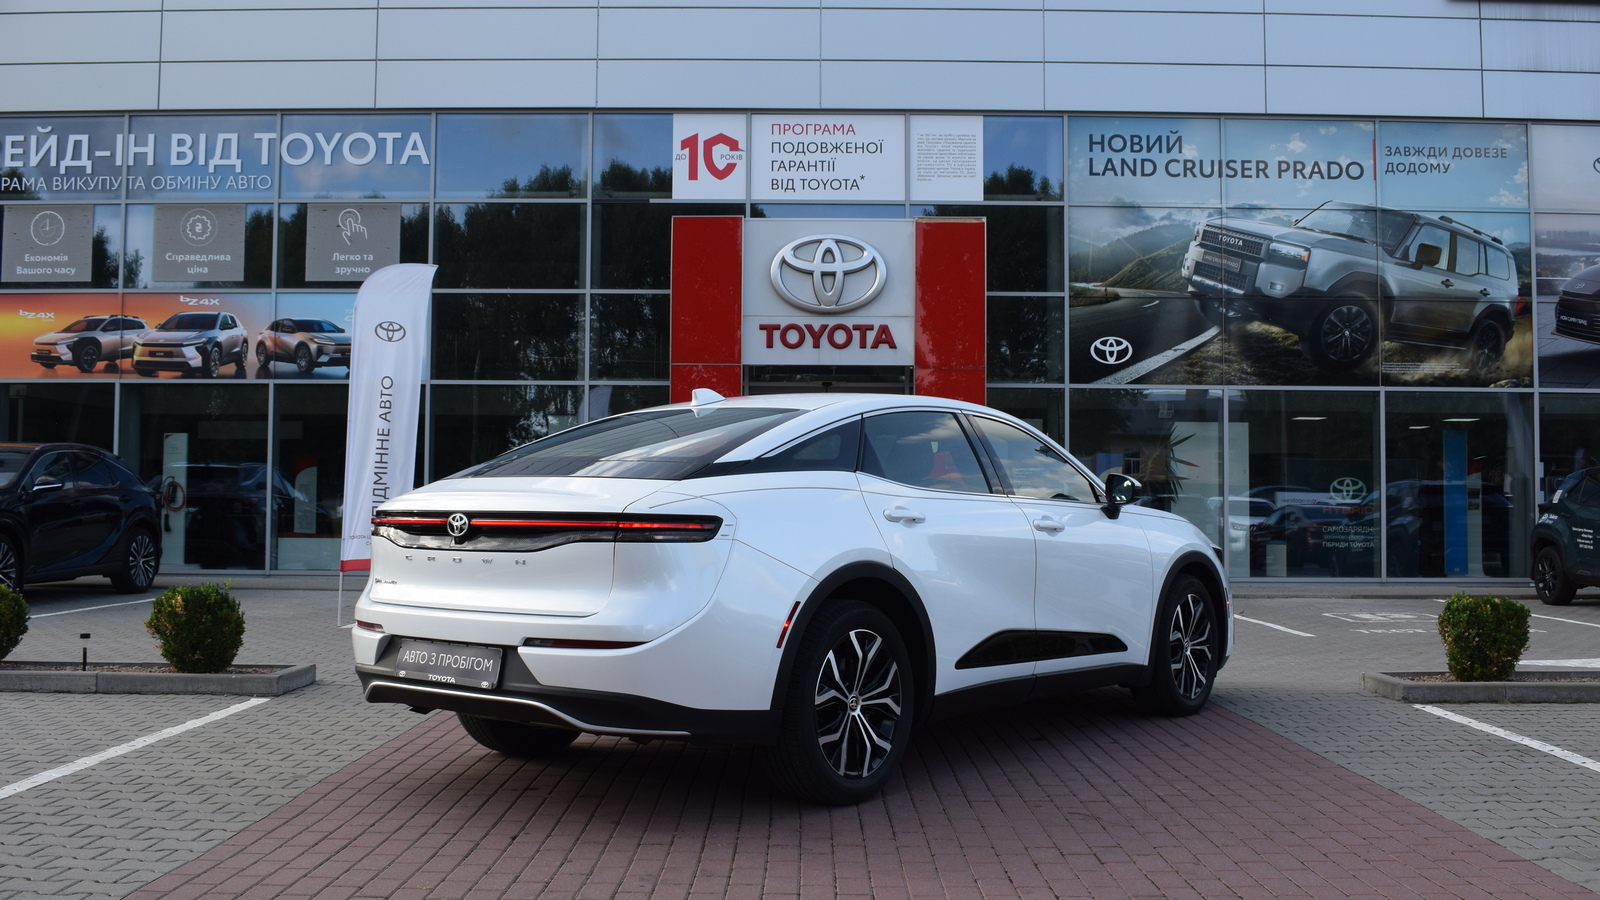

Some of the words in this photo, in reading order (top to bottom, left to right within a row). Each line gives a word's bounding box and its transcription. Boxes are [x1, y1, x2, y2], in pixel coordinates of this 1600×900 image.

[771, 123, 856, 136] ПРОГРАМА
[771, 139, 884, 156] ПОДОВЖЕНОЇ
[1088, 130, 1183, 154] НОВИЙ
[170, 132, 243, 173] ВІД
[253, 131, 431, 166] TOYOTA
[674, 153, 687, 161] ДО
[720, 153, 743, 161] РОКІВ
[1384, 145, 1448, 160] ЗАВЖДИ
[1451, 146, 1508, 161] ДОВЕЗЕ
[771, 157, 837, 172] ГАРАНТІЇ
[1088, 157, 1158, 178] LAND
[1164, 158, 1270, 180] CRUISER
[1277, 160, 1366, 181] PRADO
[1384, 162, 1451, 176] ДОДОМУ
[1, 176, 47, 191] РАМА
[52, 176, 122, 191] ВИКУПУ
[127, 175, 146, 190] ТА
[151, 175, 221, 190] ОБМІНУ
[225, 174, 272, 190] АВТО
[771, 178, 796, 193] ВІД
[1218, 234, 1243, 246] TOYOTA
[24, 253, 69, 262] Економія
[165, 252, 231, 264] Справедлива
[332, 252, 361, 262] Легко
[362, 254, 374, 262] та
[16, 265, 53, 275] Вашого
[54, 267, 76, 276] часу
[187, 264, 209, 275] ціна
[335, 266, 371, 275] зручно
[758, 323, 898, 350] TOYOTA
[379, 376, 394, 423] АВТО
[1323, 505, 1375, 515] HYBRID
[1322, 525, 1373, 534] САМОЗАРЯДН
[405, 555, 526, 566] CROWN
[402, 650, 428, 665] АВТО
[428, 652, 437, 666] З
[437, 653, 494, 673] ПРОБІГОМ
[428, 673, 456, 684] TOYOTA
